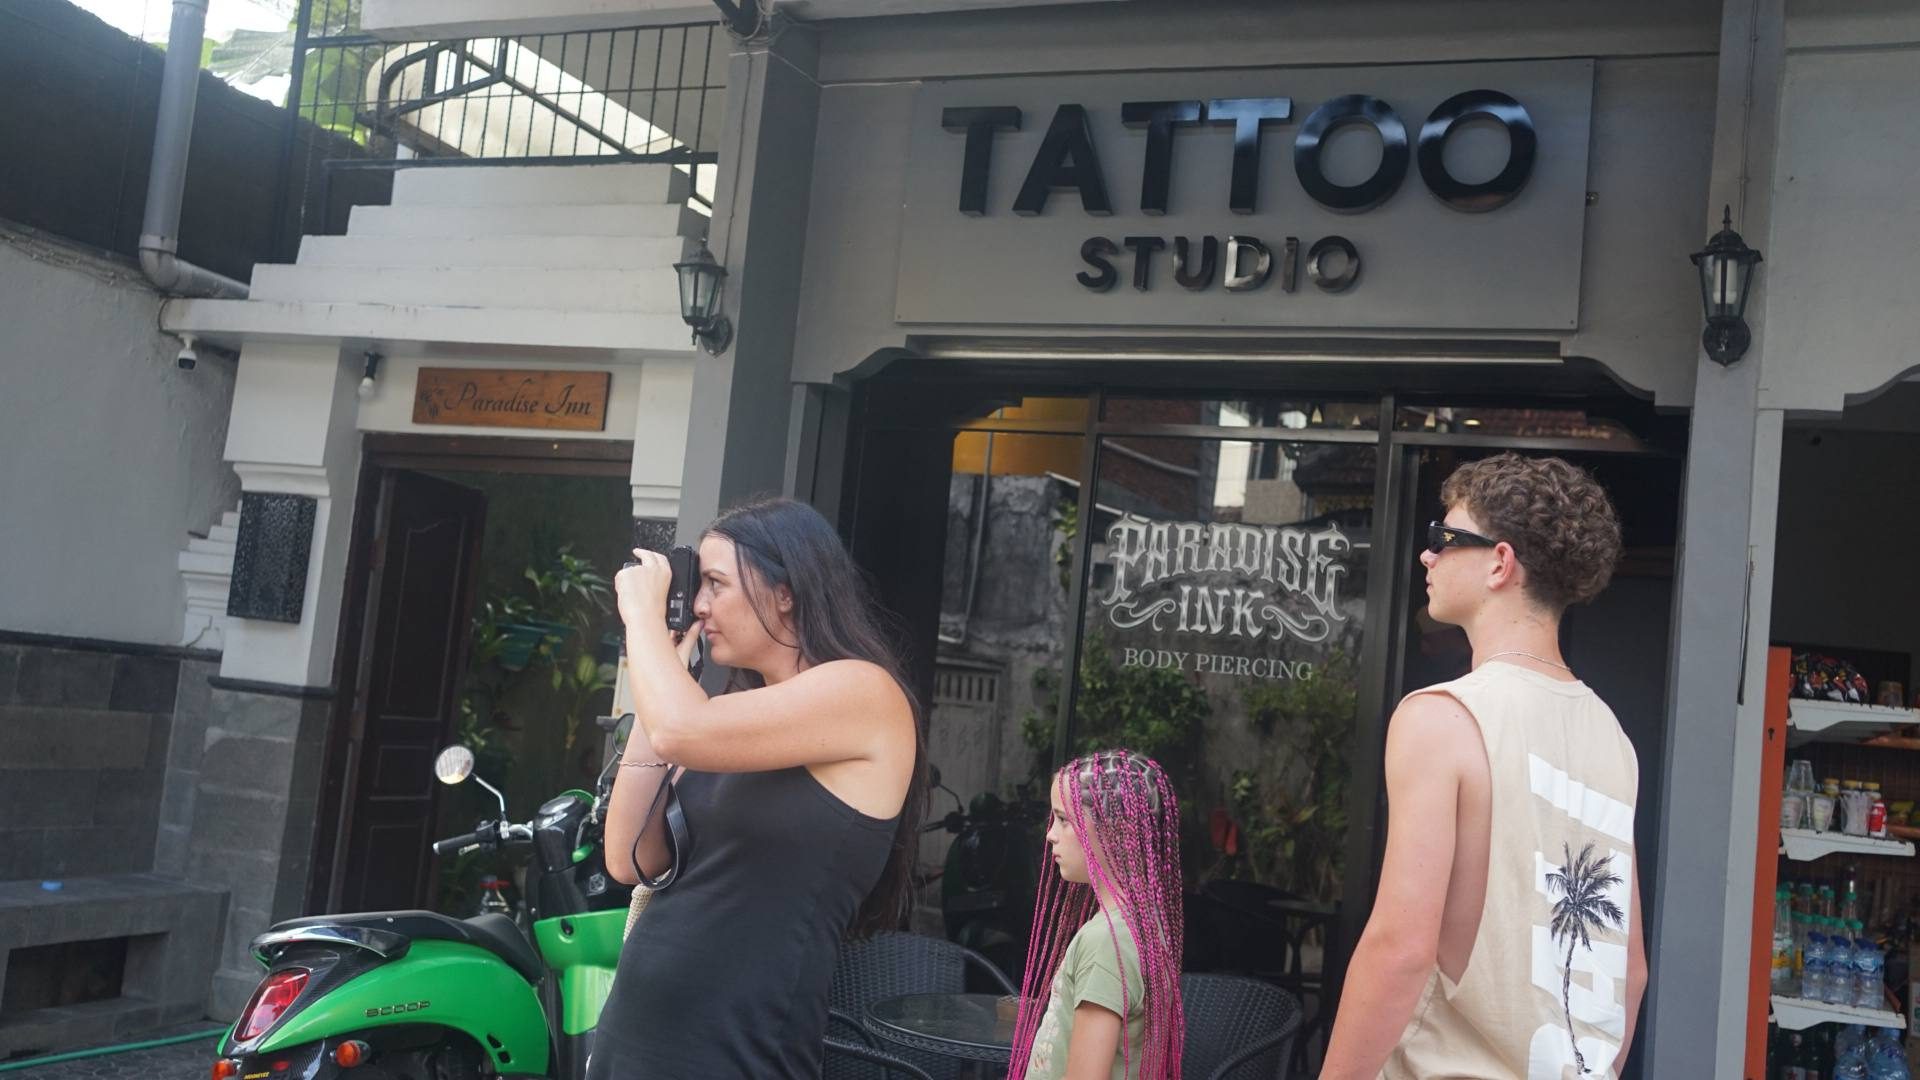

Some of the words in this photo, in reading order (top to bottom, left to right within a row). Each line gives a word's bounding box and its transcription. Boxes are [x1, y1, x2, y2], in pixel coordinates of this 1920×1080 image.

[941, 89, 1536, 216] TATTOO
[1076, 235, 1361, 293] STUDIO
[443, 378, 539, 415] Paradise
[544, 383, 592, 416] Inn
[1102, 512, 1350, 621] PARADISE
[1175, 585, 1264, 638] INK
[1124, 648, 1190, 671] BODY
[1196, 653, 1312, 681] PIERCING
